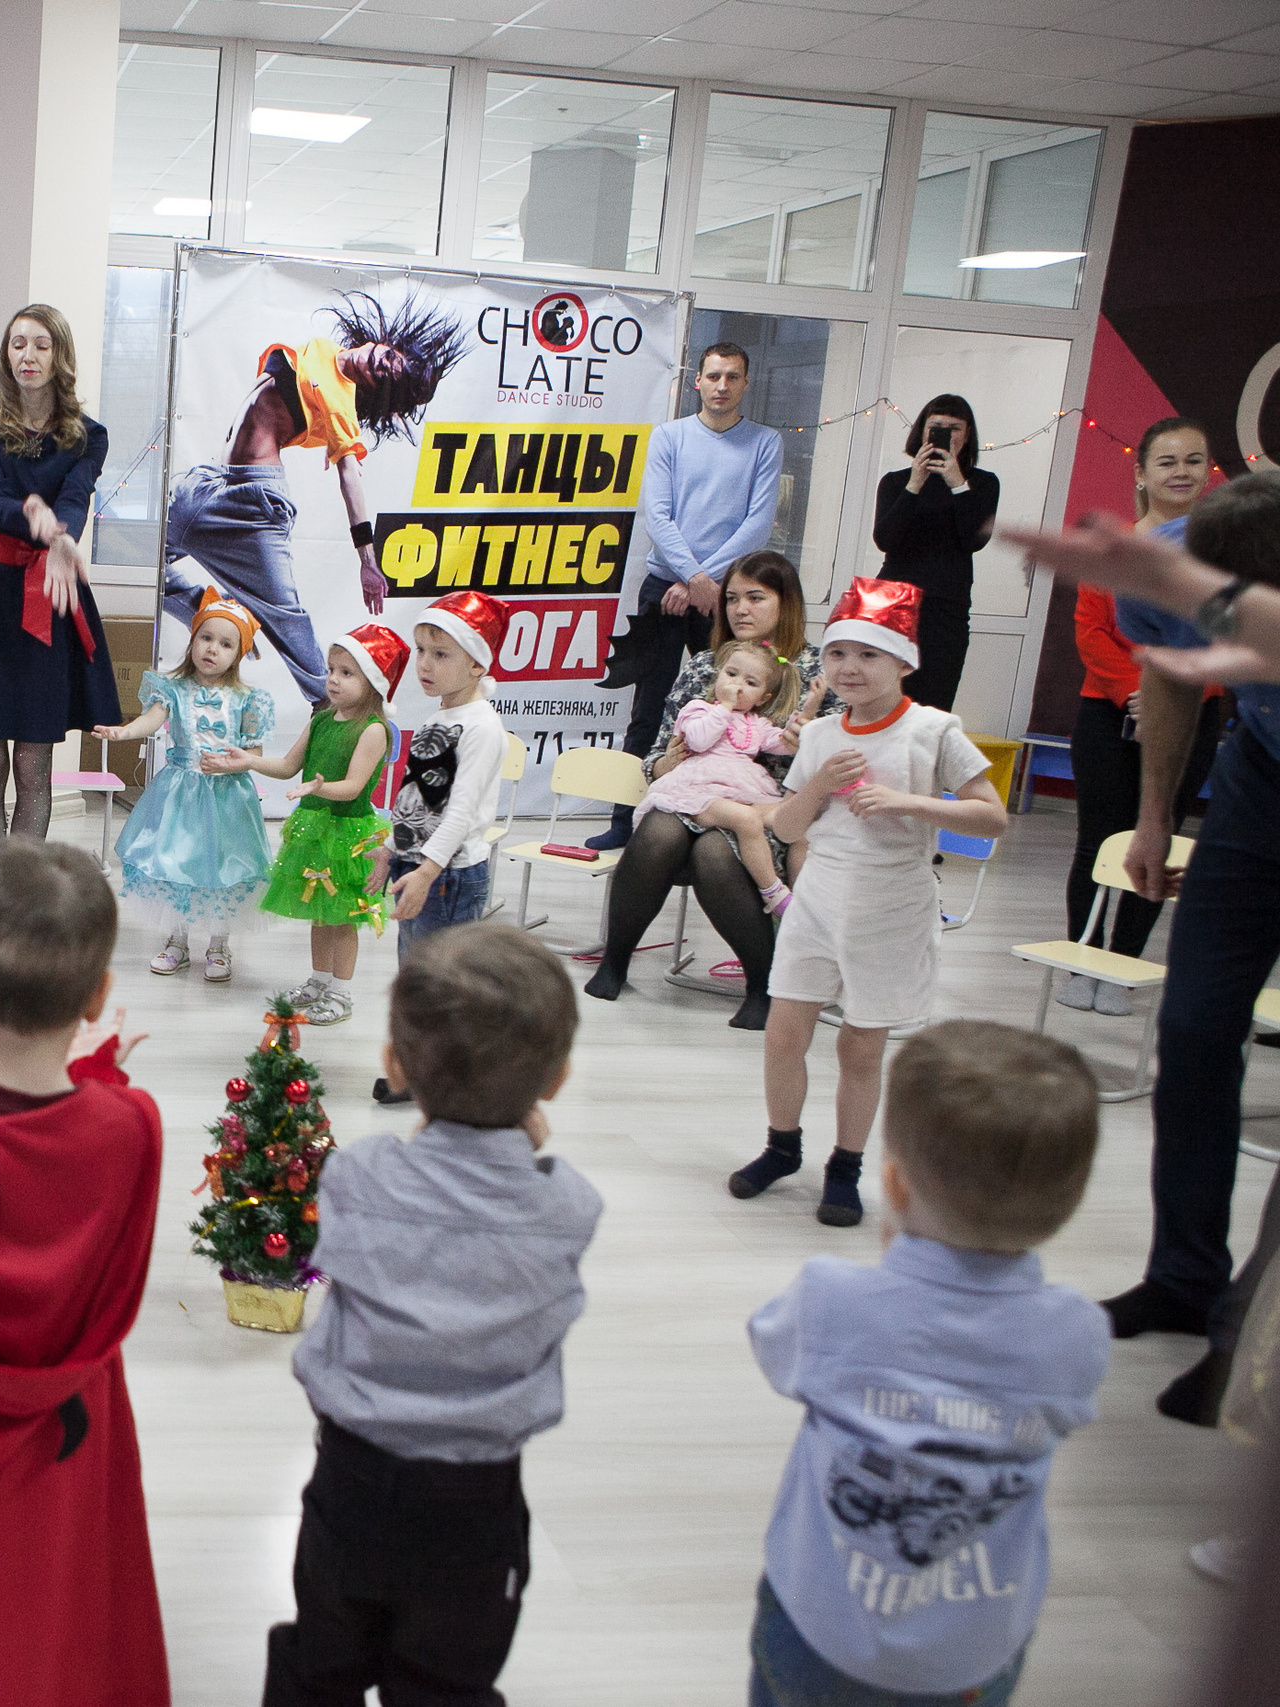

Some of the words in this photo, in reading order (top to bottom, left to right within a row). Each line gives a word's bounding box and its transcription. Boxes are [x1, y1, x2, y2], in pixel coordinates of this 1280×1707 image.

[477, 292, 643, 356] CHOCO
[497, 390, 549, 406] DANCE
[556, 394, 603, 409] STUDIO
[498, 350, 608, 396] LATE
[431, 432, 639, 503] ТАНЦЫ
[381, 523, 620, 588] ФИТНЕС
[498, 610, 598, 672] ОГА
